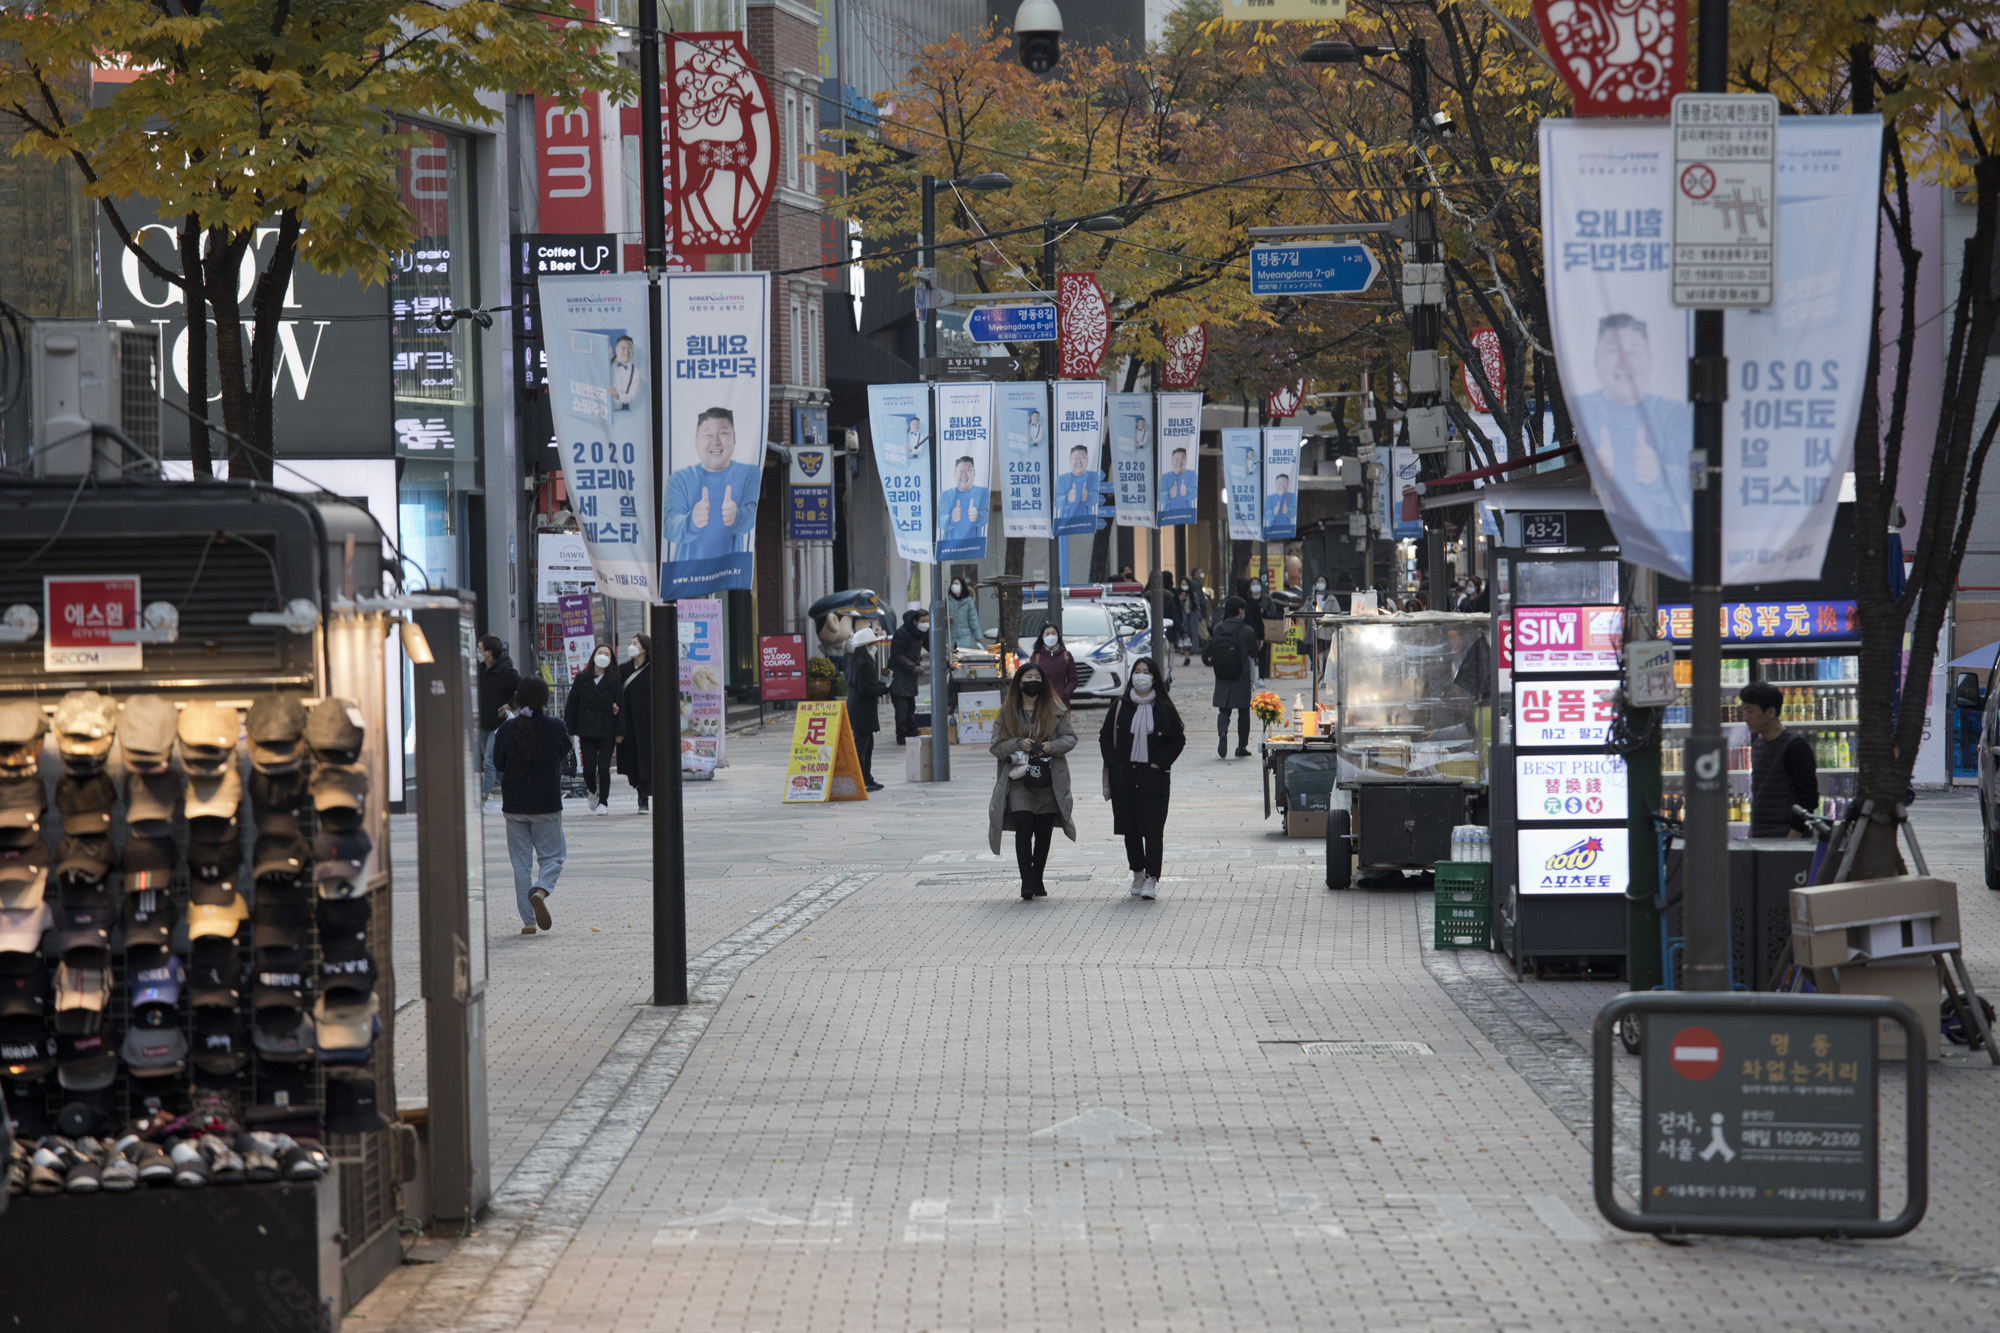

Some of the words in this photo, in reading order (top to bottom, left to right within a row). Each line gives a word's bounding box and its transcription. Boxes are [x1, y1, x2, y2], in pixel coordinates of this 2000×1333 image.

[538, 246, 576, 258] Coffee
[1354, 254, 1363, 263] 26
[538, 260, 548, 271] &
[550, 260, 576, 271] Beer
[1257, 251, 1299, 267] 명동7길
[1257, 270, 1313, 281] Myeongdong
[1315, 268, 1335, 279] 7-gil
[1018, 308, 1054, 321] 명동8길
[988, 323, 1036, 332] Myeongdong
[1036, 322, 1054, 330] 8-gil
[686, 334, 748, 357] 힘내요
[676, 356, 756, 380] 대한민국
[949, 416, 982, 428] 힘내요
[1065, 410, 1095, 421] 힘내요
[1060, 421, 1099, 432] 대한민국
[1168, 418, 1193, 427] 힘내요
[943, 429, 987, 441] 대한민국
[1164, 426, 1196, 437] 대한민국
[573, 442, 635, 464] 2020
[1009, 461, 1041, 472] 2020
[1118, 461, 1146, 472] 2020
[576, 468, 635, 490] 코리아
[884, 475, 921, 489] 2020
[1010, 473, 1041, 486] 코리아
[1120, 472, 1146, 482] 코리아
[888, 490, 921, 503] 코리아
[1011, 500, 1042, 511] 페스타
[1526, 522, 1562, 538] 43-2
[630, 575, 648, 587] 15일
[64, 602, 124, 627] 에스원
[688, 612, 718, 620] Massage
[1561, 614, 1575, 622] LTE
[1518, 618, 1575, 646] SIM
[52, 652, 99, 665] SECOM
[802, 717, 827, 746] 足
[1542, 728, 1566, 740] 사고
[800, 762, 829, 773] ₩18,000
[1523, 762, 1567, 776] BEST
[1572, 760, 1623, 774] PRICE
[1545, 848, 1598, 870] toto
[1540, 875, 1612, 888] 스포츠토토
[137, 970, 171, 982] KOREA
[1657, 1110, 1702, 1135] 걷자,
[1742, 1129, 1771, 1146] 매일
[1776, 1130, 1860, 1147] 10:00~23:00
[1658, 1138, 1696, 1162] 서울
